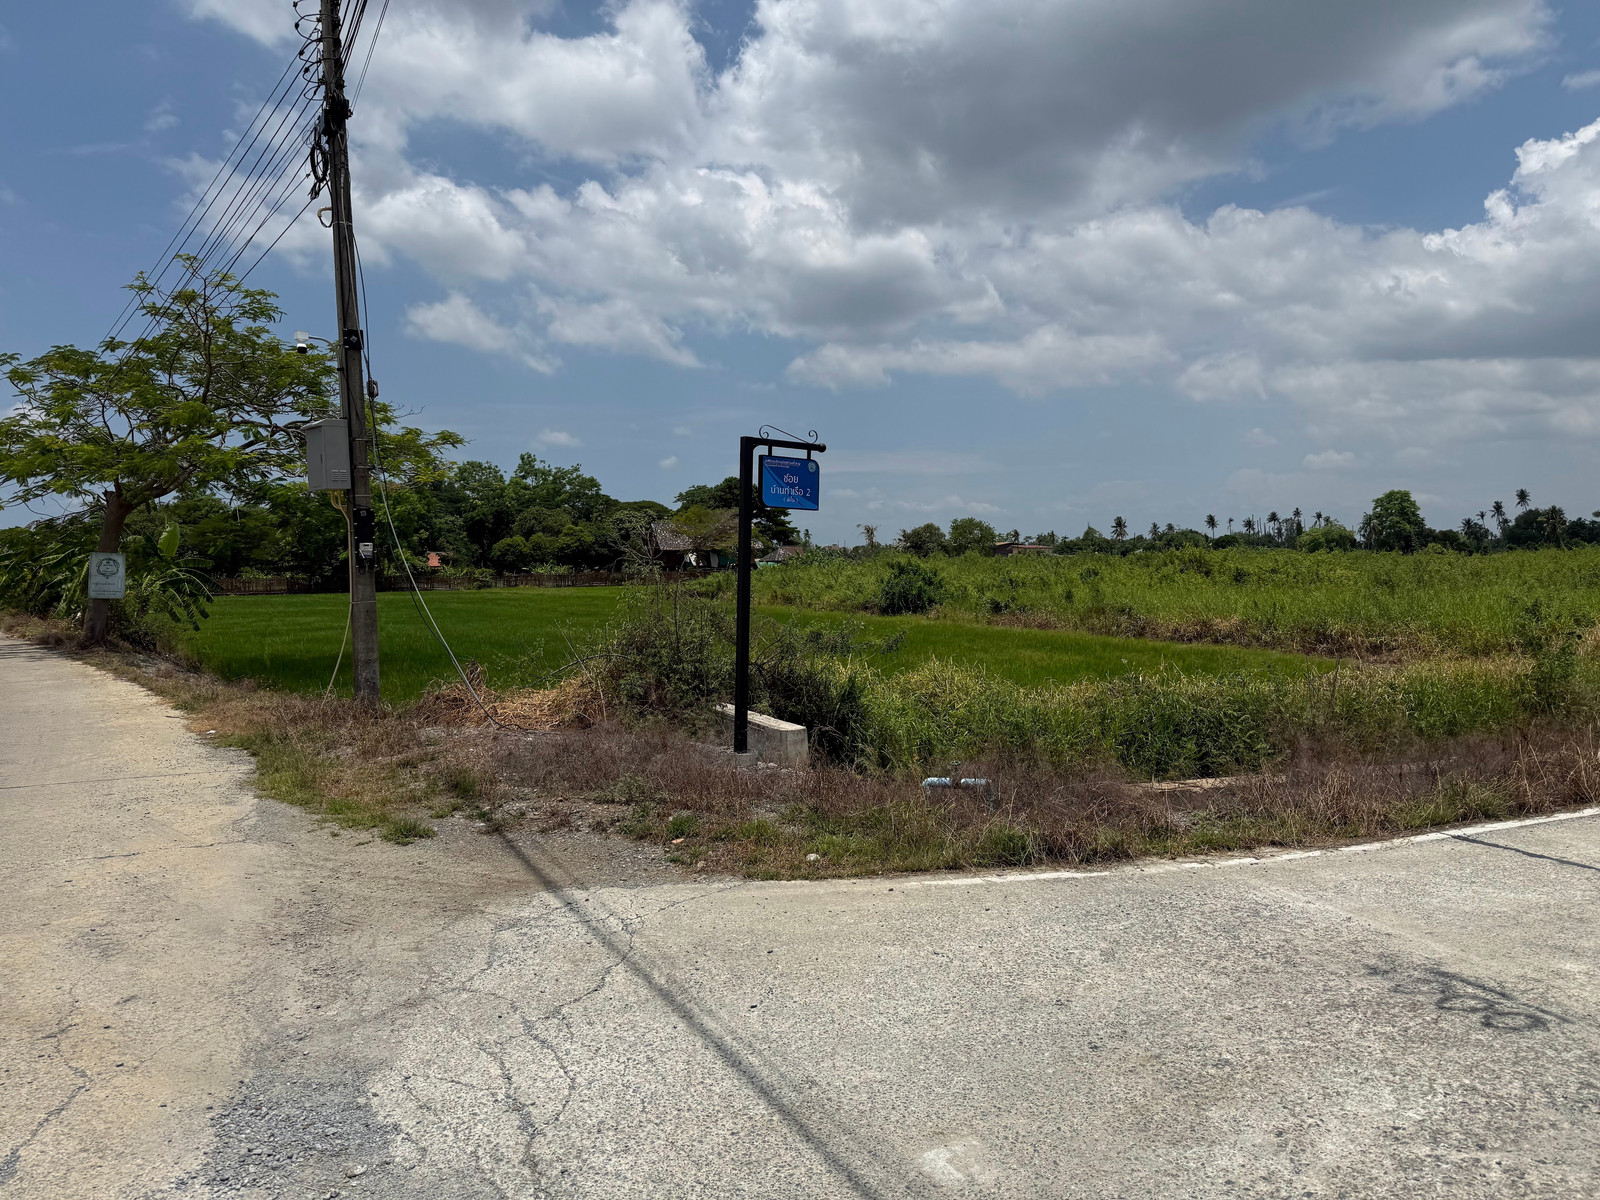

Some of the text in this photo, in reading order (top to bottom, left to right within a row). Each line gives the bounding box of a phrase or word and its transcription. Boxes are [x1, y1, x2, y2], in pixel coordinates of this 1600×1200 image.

[784, 473, 798, 484] ซอย
[770, 484, 811, 496] บ้านท่าเรือ 2
